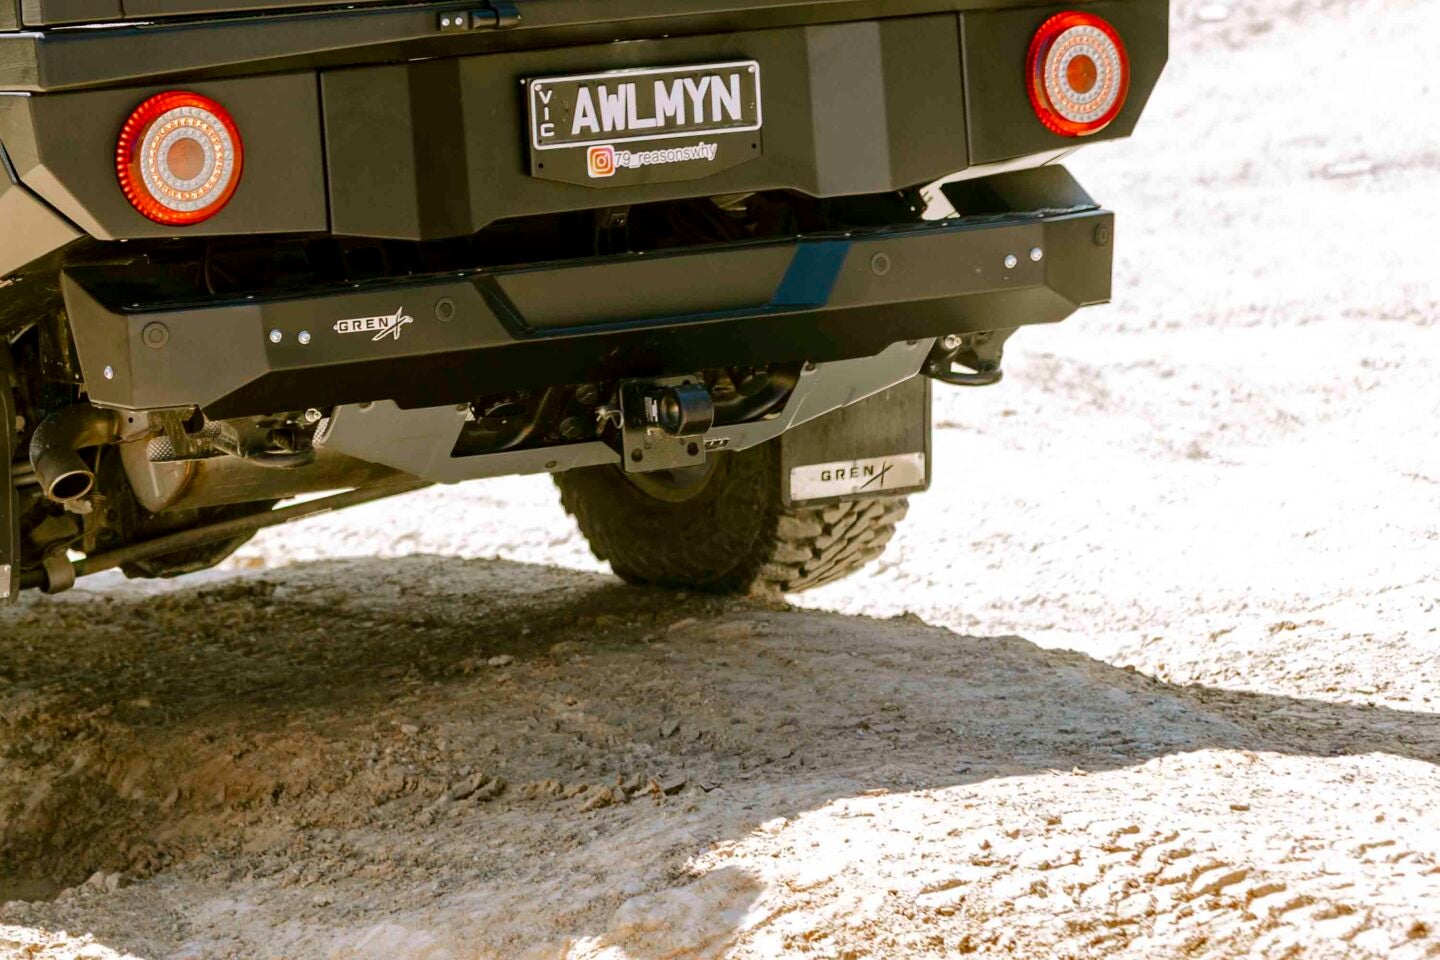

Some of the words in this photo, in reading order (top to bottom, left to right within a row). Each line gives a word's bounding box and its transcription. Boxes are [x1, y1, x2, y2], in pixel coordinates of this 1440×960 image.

[539, 90, 555, 137] VIC
[571, 73, 741, 135] AWLMYN
[614, 142, 717, 168] 79_reasonswhy
